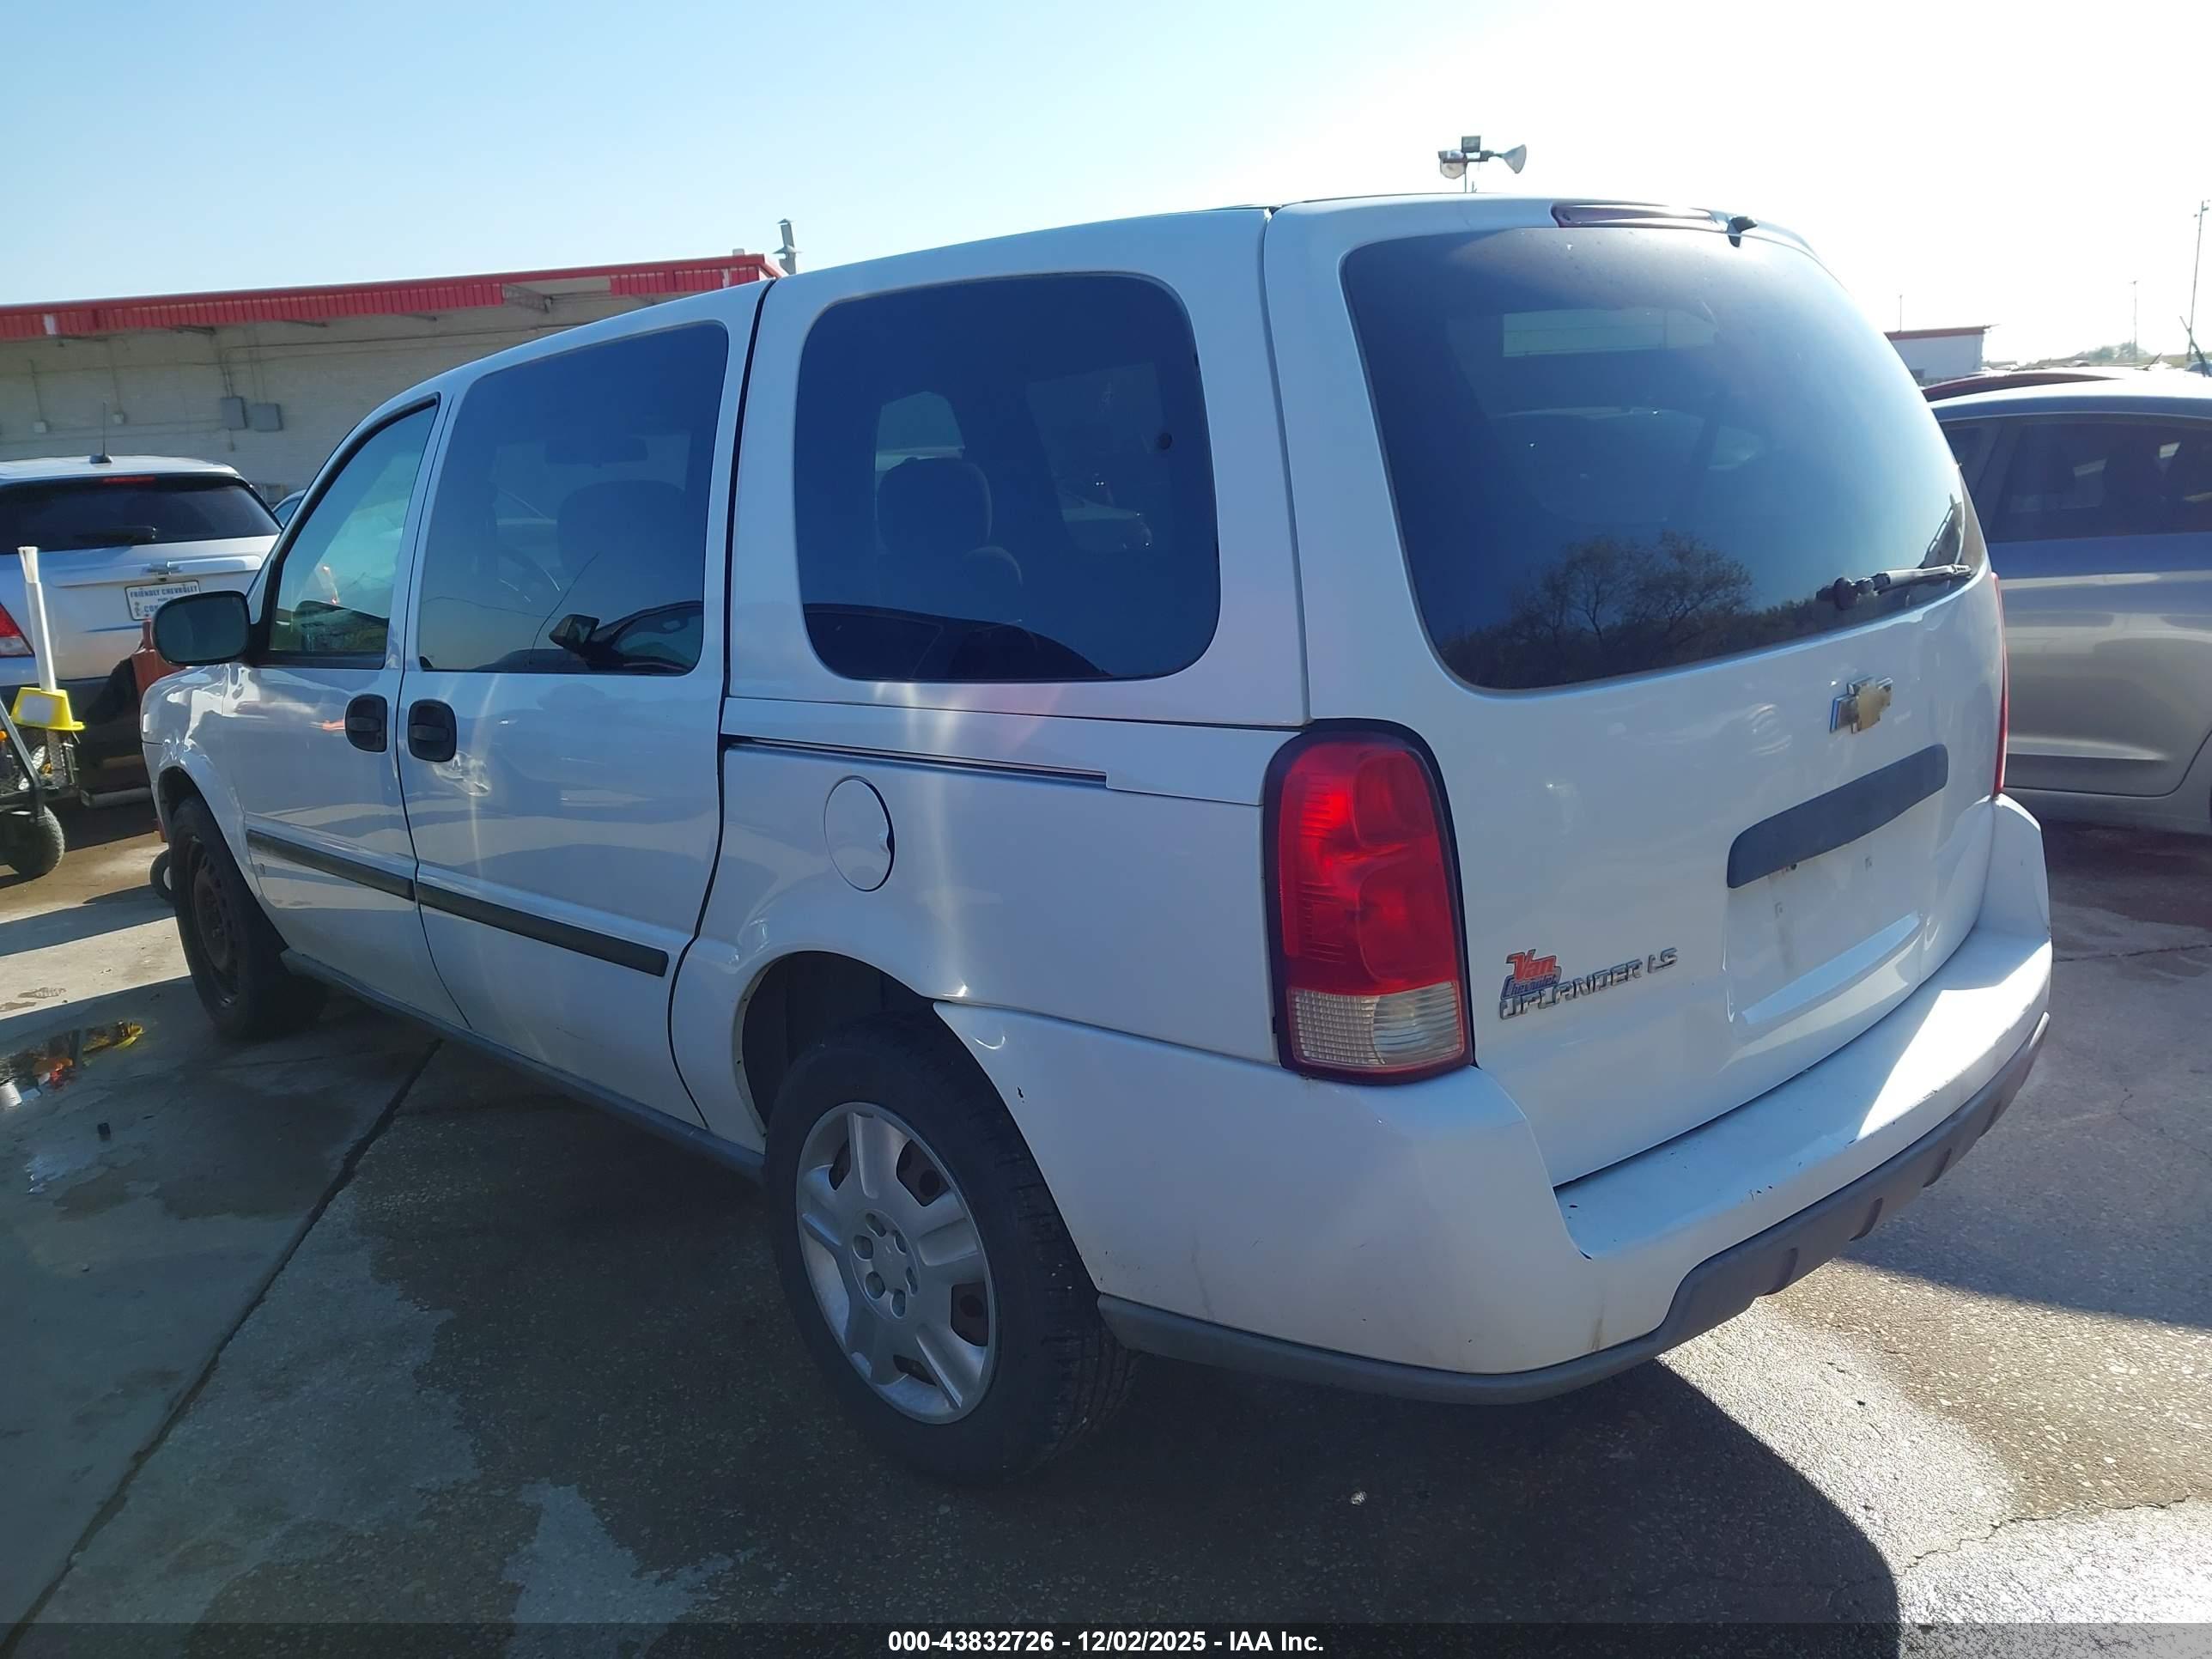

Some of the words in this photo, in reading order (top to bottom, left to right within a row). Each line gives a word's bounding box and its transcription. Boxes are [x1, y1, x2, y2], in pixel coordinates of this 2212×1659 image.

[130, 589, 160, 599] FRIENDLY
[161, 586, 198, 595] CHEVROLET
[1505, 948, 1557, 981] Van
[1499, 958, 1643, 1019] UPLANDER
[1647, 947, 1678, 974] LS
